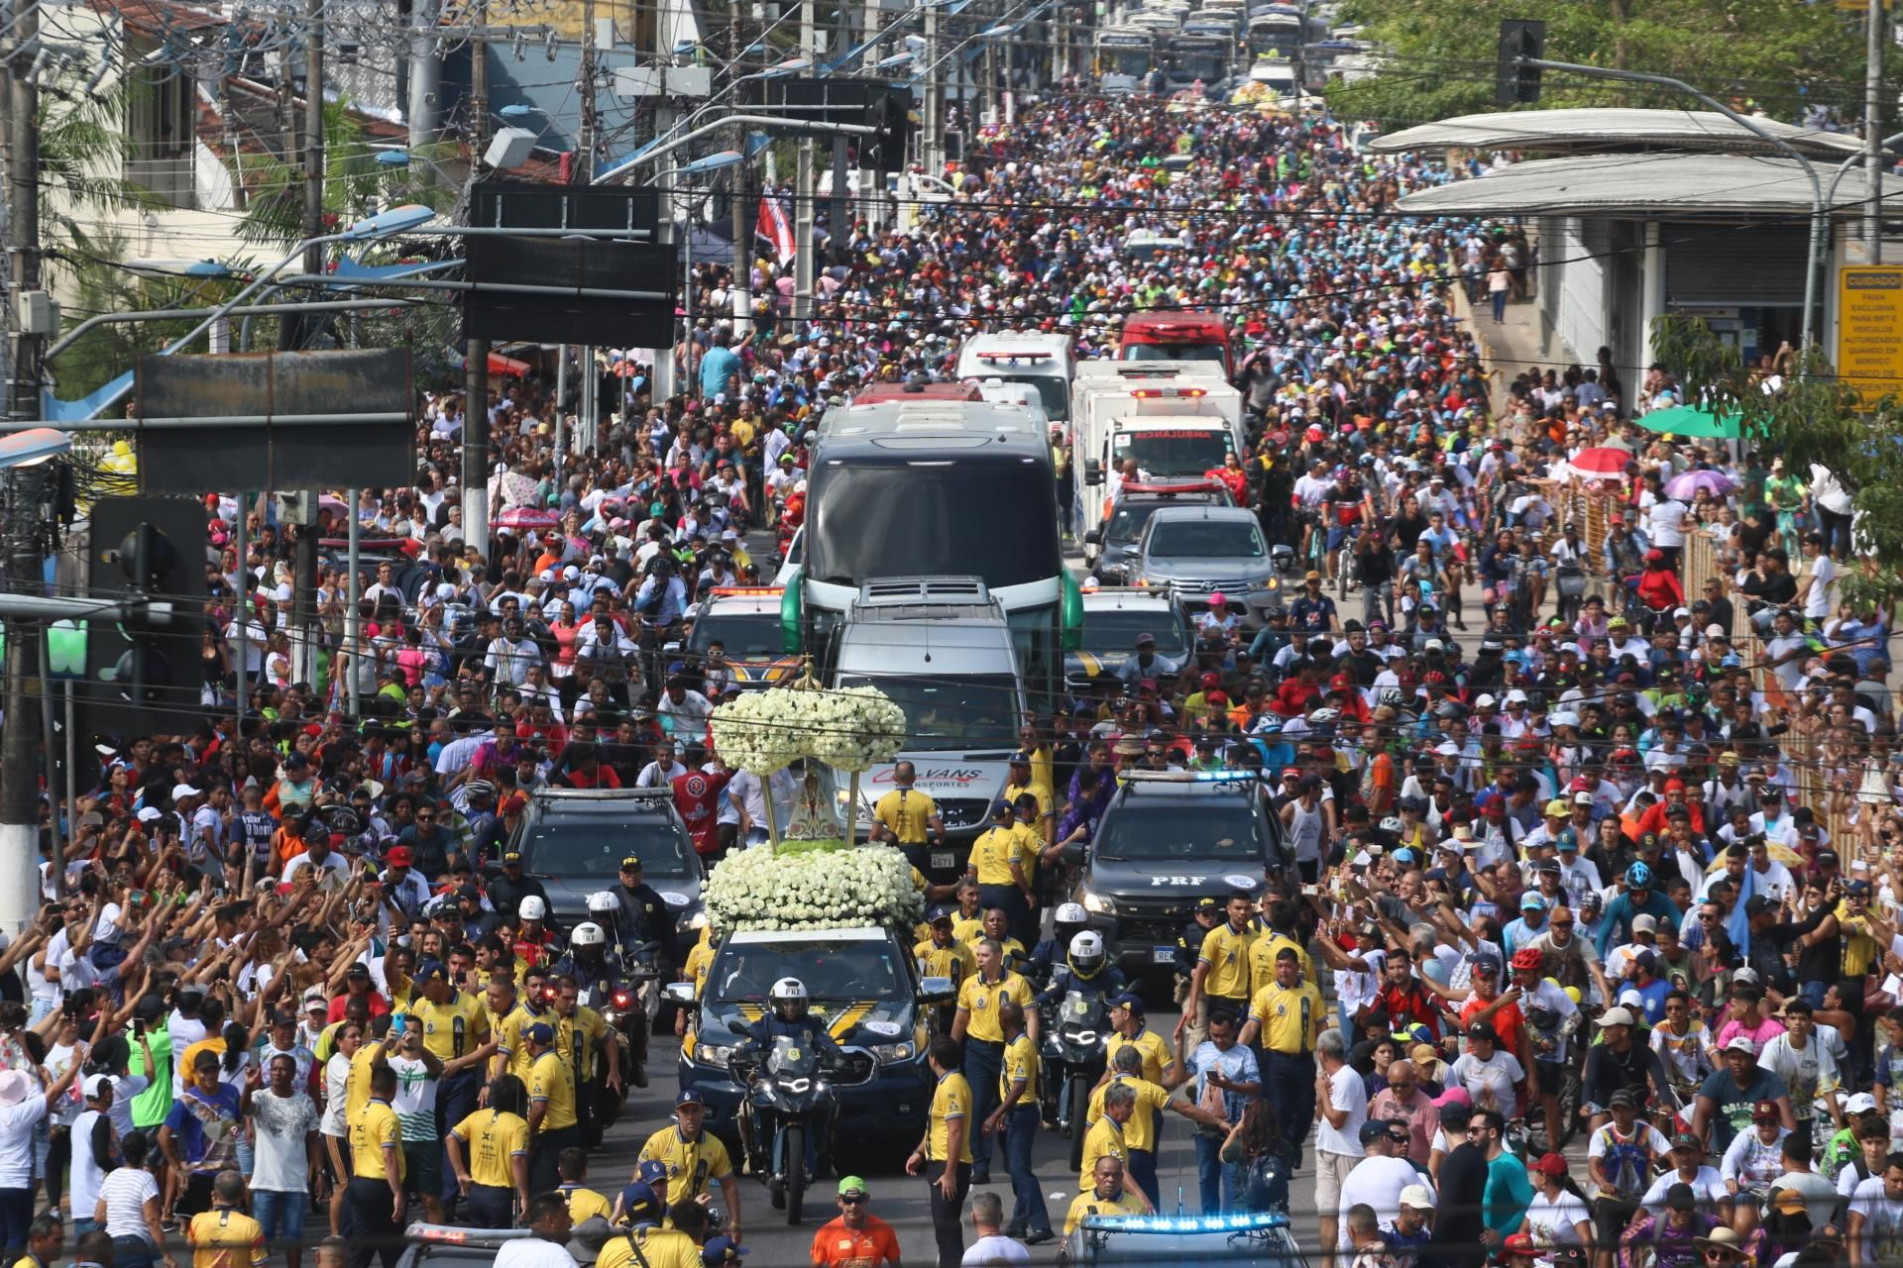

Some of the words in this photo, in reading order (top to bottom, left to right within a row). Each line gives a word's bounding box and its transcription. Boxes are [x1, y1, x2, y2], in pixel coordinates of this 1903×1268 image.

[926, 769, 982, 778] VANS
[1151, 876, 1207, 886] PRF
[786, 988, 800, 996] PRF
